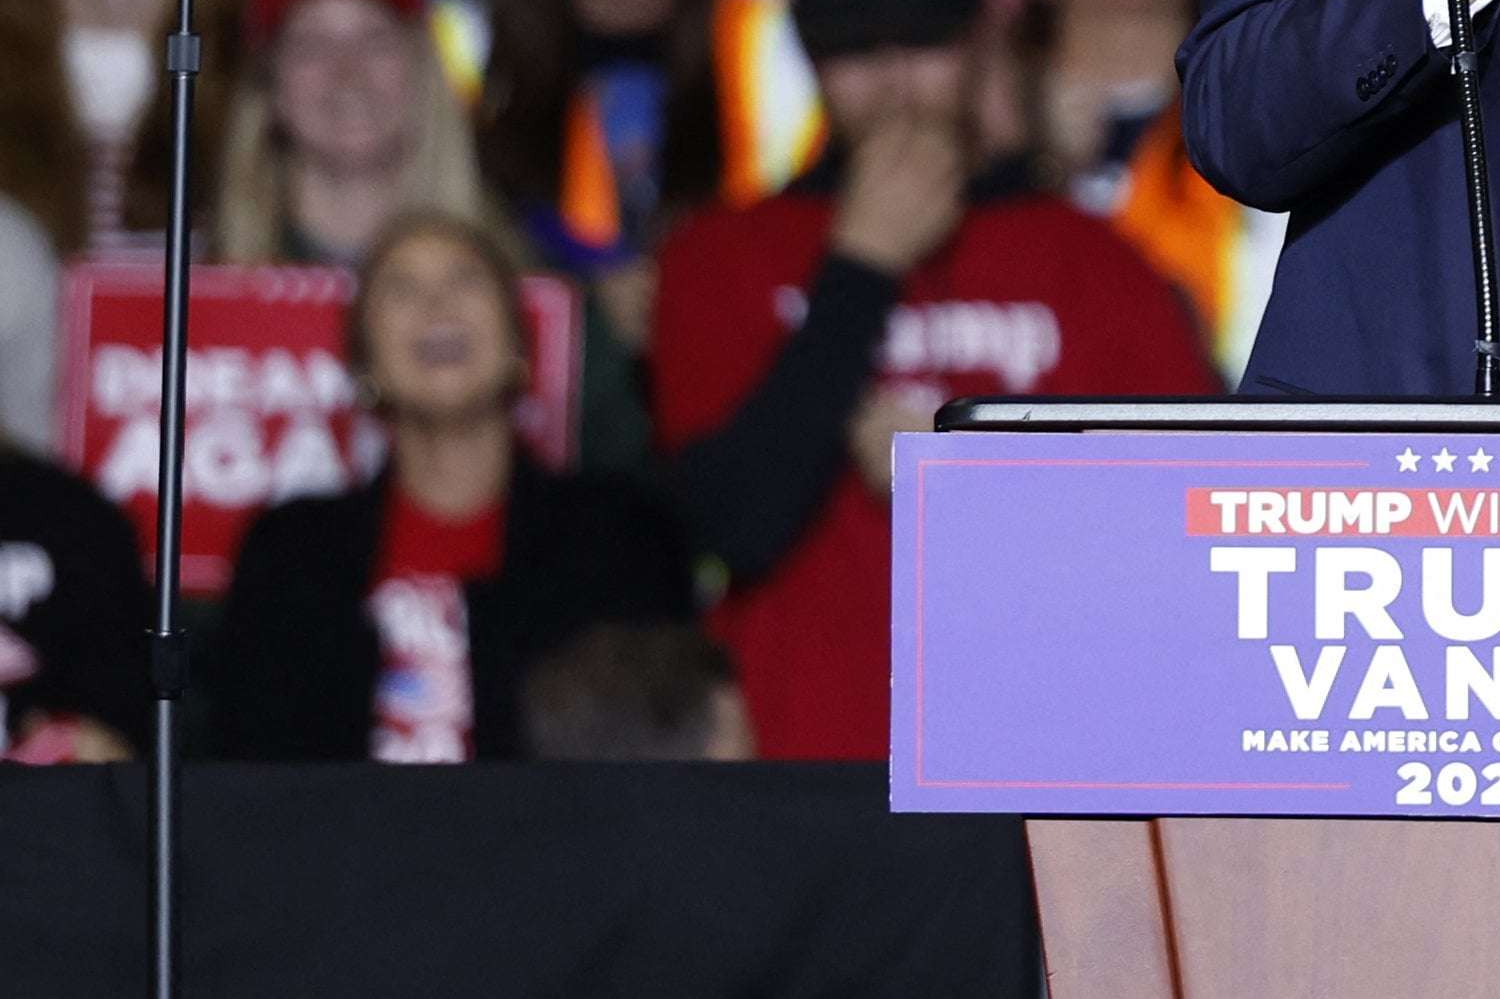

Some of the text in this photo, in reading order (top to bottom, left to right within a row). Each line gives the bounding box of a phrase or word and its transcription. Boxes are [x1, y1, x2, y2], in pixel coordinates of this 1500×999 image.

[1211, 491, 1412, 534] TRUMP
[1242, 730, 1330, 753] MAKE
[1339, 730, 1483, 753] AMERICA
